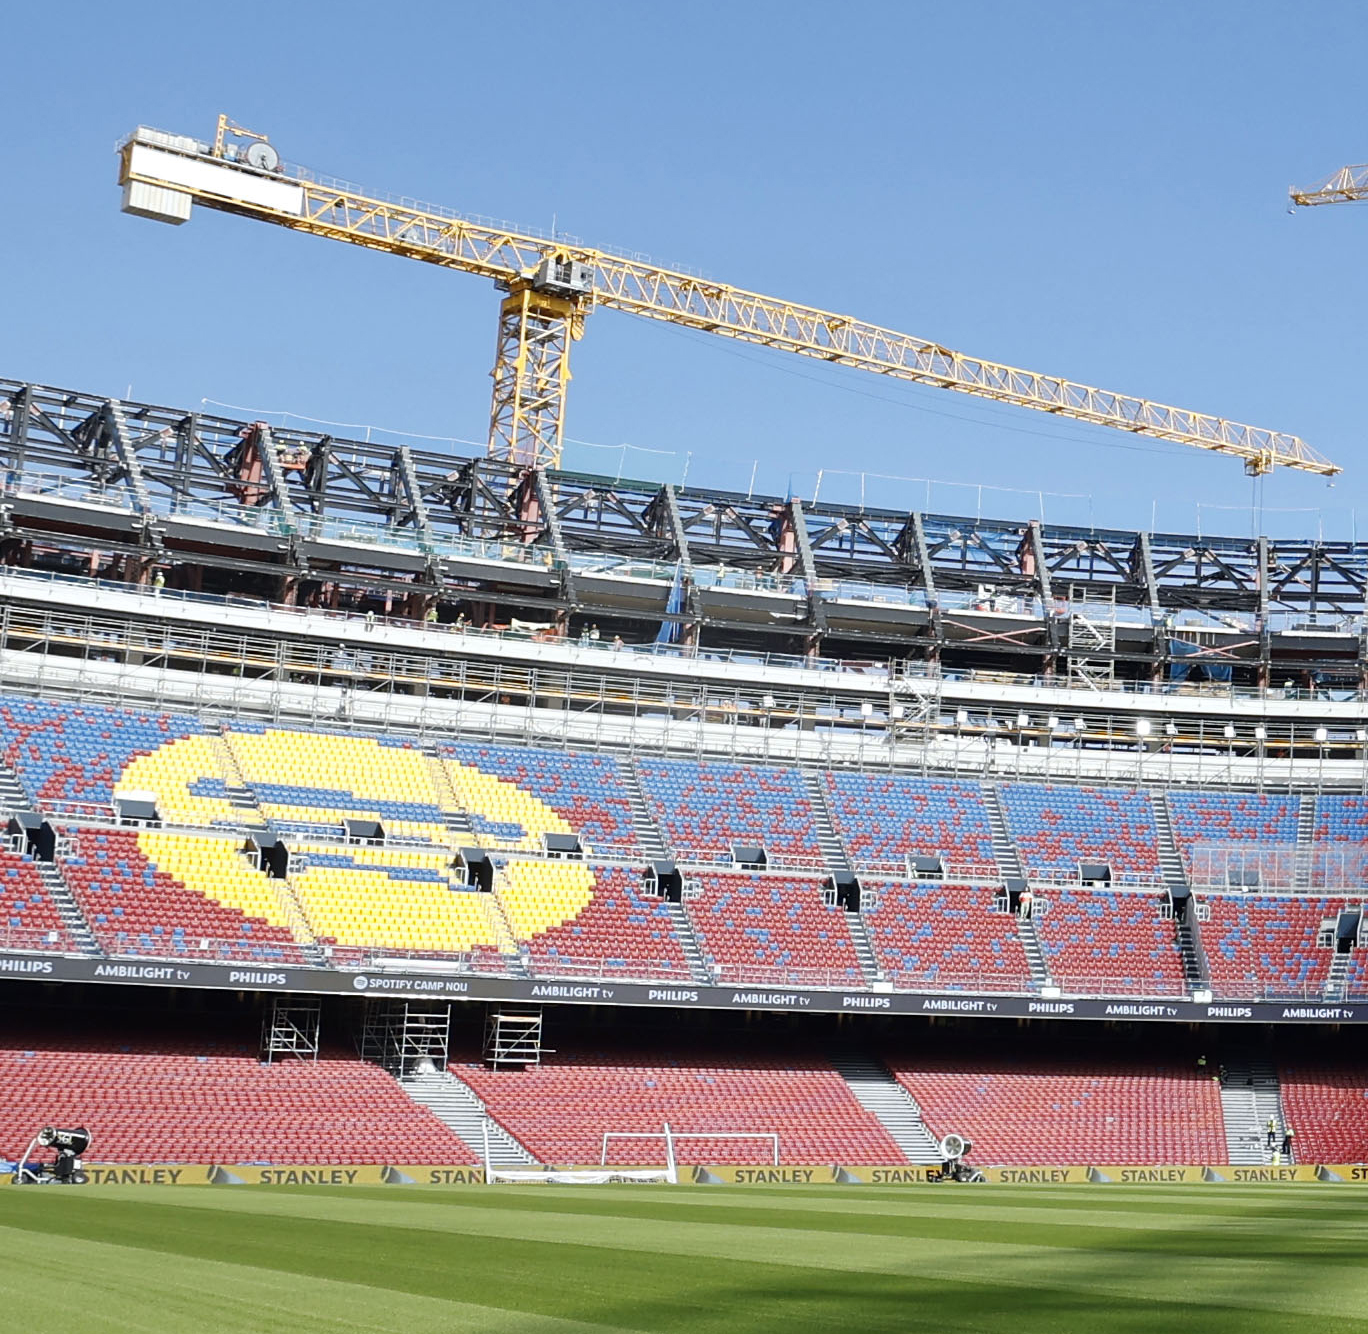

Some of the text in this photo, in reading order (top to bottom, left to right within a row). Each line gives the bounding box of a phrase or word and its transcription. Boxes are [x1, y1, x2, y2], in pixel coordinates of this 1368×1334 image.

[0, 960, 52, 973] HILIPS
[95, 965, 190, 979] AMBILIGHT tv
[230, 972, 285, 984] PHILIPS
[369, 978, 467, 991] SPOTIFY CAMP NOU
[532, 986, 613, 998] AMBILIGHT tv
[649, 990, 698, 1001] PHILIPS
[732, 994, 810, 1005] AMBILIGHT tv
[843, 997, 890, 1007] PHILIPS
[923, 1000, 997, 1011] AMBILIGHT tv
[1029, 1003, 1074, 1013] PHILIPS
[1106, 1005, 1165, 1015] AMBILIGHT
[1208, 1007, 1251, 1017] PHILIPS
[1283, 1009, 1341, 1018] AMBILIGHT
[260, 1169, 358, 1184] STANLEY
[430, 1170, 486, 1184] STAN
[735, 1169, 813, 1183] STANLEY
[1000, 1169, 1069, 1183] STANLEY
[1121, 1169, 1186, 1182] STANLEY
[1234, 1169, 1297, 1181] STANLEY
